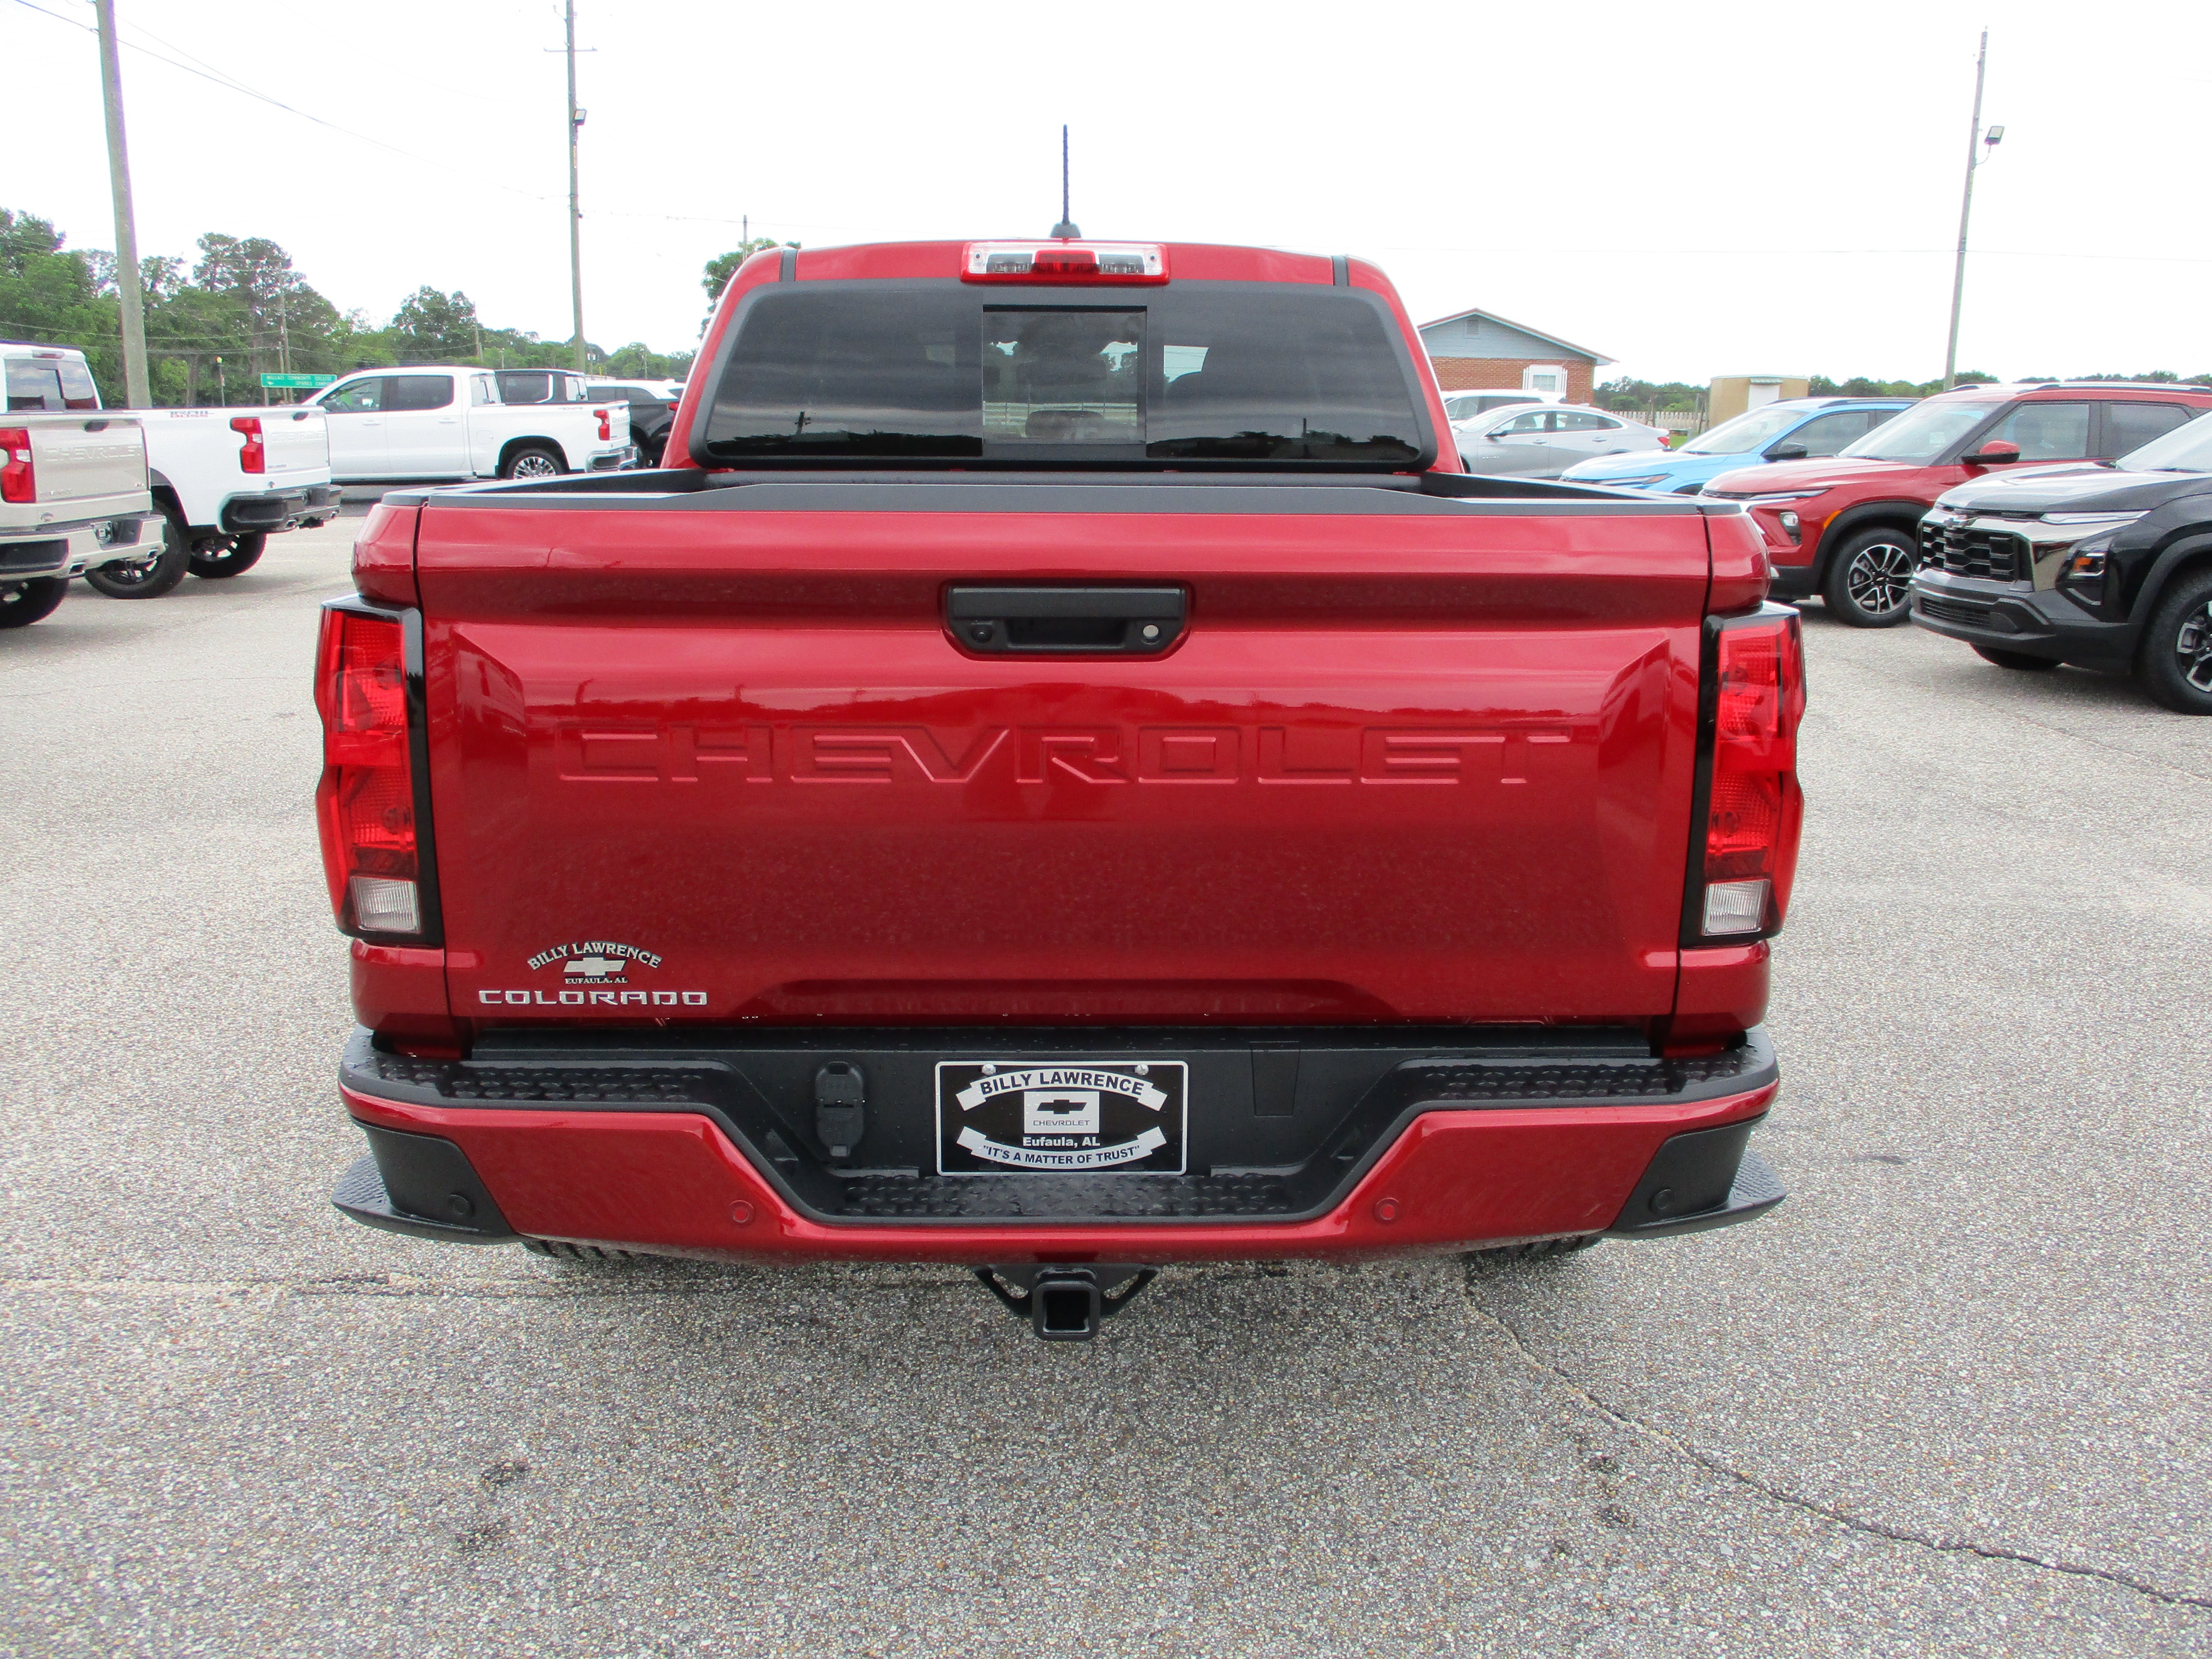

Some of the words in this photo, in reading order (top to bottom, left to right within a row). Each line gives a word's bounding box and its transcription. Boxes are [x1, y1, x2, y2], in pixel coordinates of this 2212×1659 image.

[44, 444, 142, 462] CHEVROLET
[557, 720, 1571, 784] CHEVROLET
[527, 944, 569, 970] BILLY
[571, 941, 662, 969] LAWRENCE
[478, 990, 708, 1006] COLORADO
[979, 1073, 1032, 1095] BILLY
[1039, 1072, 1145, 1096] LAWRENCE
[1023, 1136, 1078, 1148] Eufaula,
[1082, 1137, 1100, 1146] AL
[983, 1145, 1010, 1159] "IT'S
[1013, 1153, 1021, 1161] A
[1025, 1153, 1073, 1164] MATTER
[1076, 1154, 1092, 1163] OF
[1096, 1145, 1140, 1162] TRUST"
